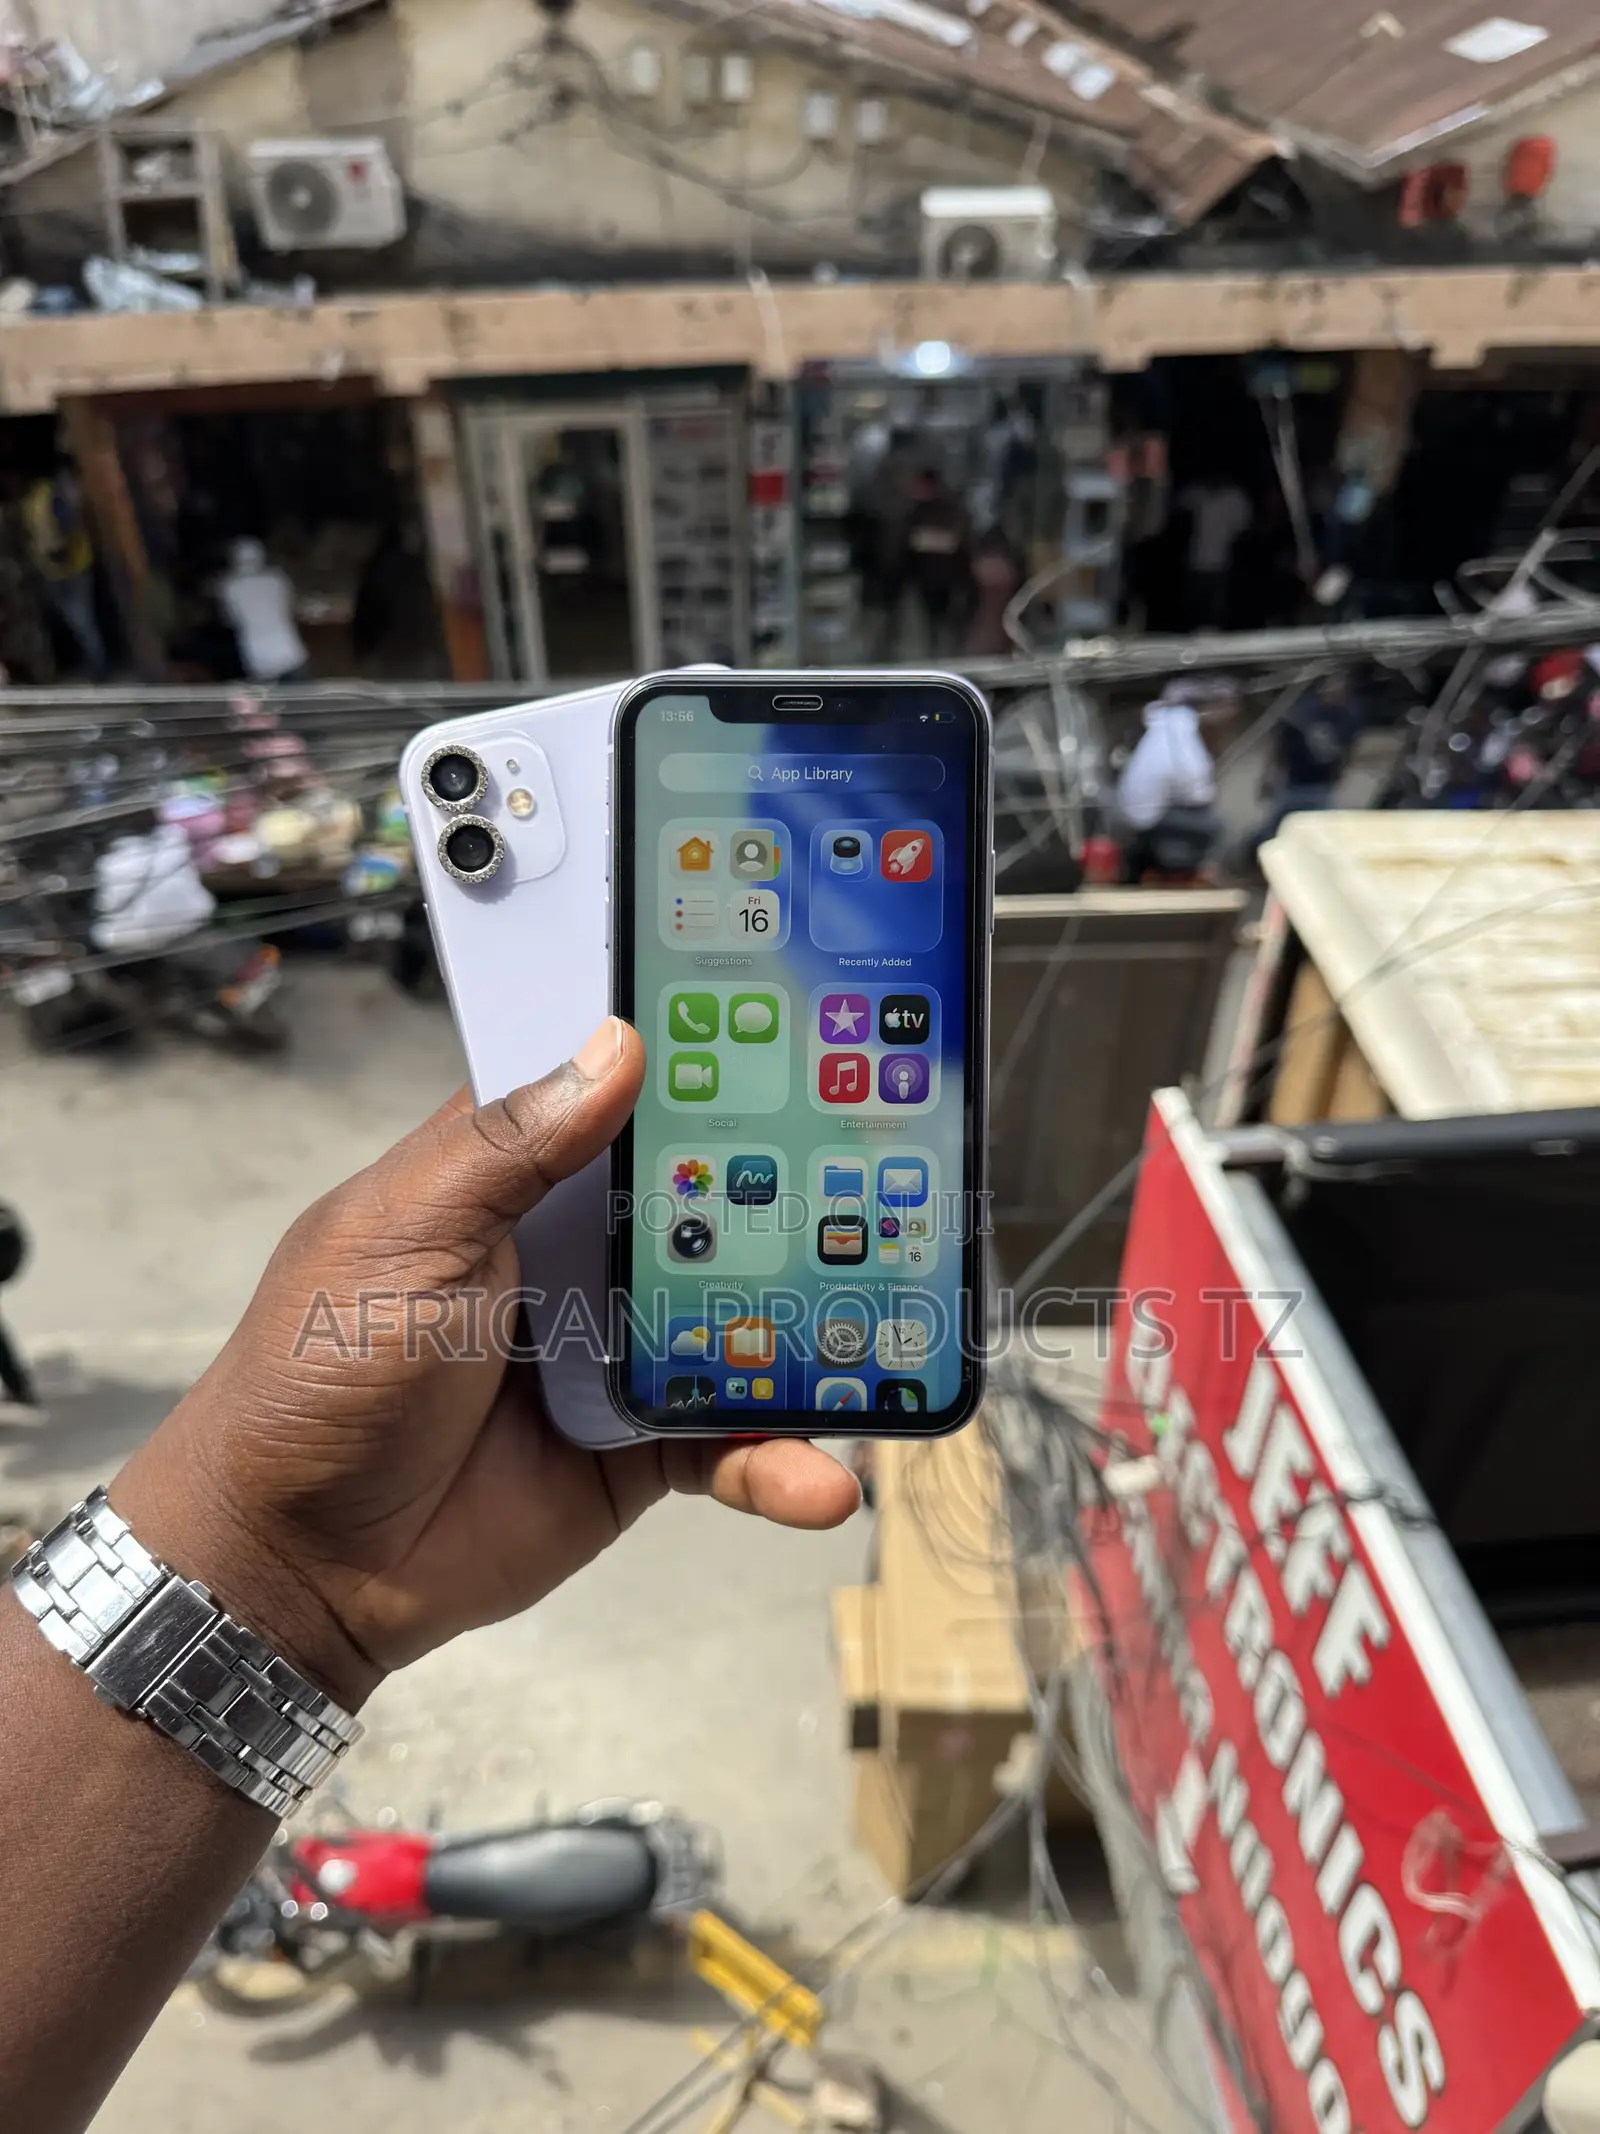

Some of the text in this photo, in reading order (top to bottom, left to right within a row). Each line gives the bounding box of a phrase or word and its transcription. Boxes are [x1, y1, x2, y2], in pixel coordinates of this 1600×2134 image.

[660, 710, 694, 722] 13:56
[771, 765, 853, 783] App Library
[747, 896, 761, 906] Fri
[738, 908, 769, 933] 16
[695, 956, 753, 967] Suggestions
[838, 956, 912, 969] Recently Added
[901, 1010, 924, 1029] tv
[708, 1117, 737, 1128] Social
[840, 1118, 907, 1130] Entertainment
[908, 1251, 922, 1263] 16
[698, 1279, 744, 1291] Creativity
[819, 1281, 924, 1293] Productivity & Finance
[1222, 1355, 1391, 1698] JEFF
